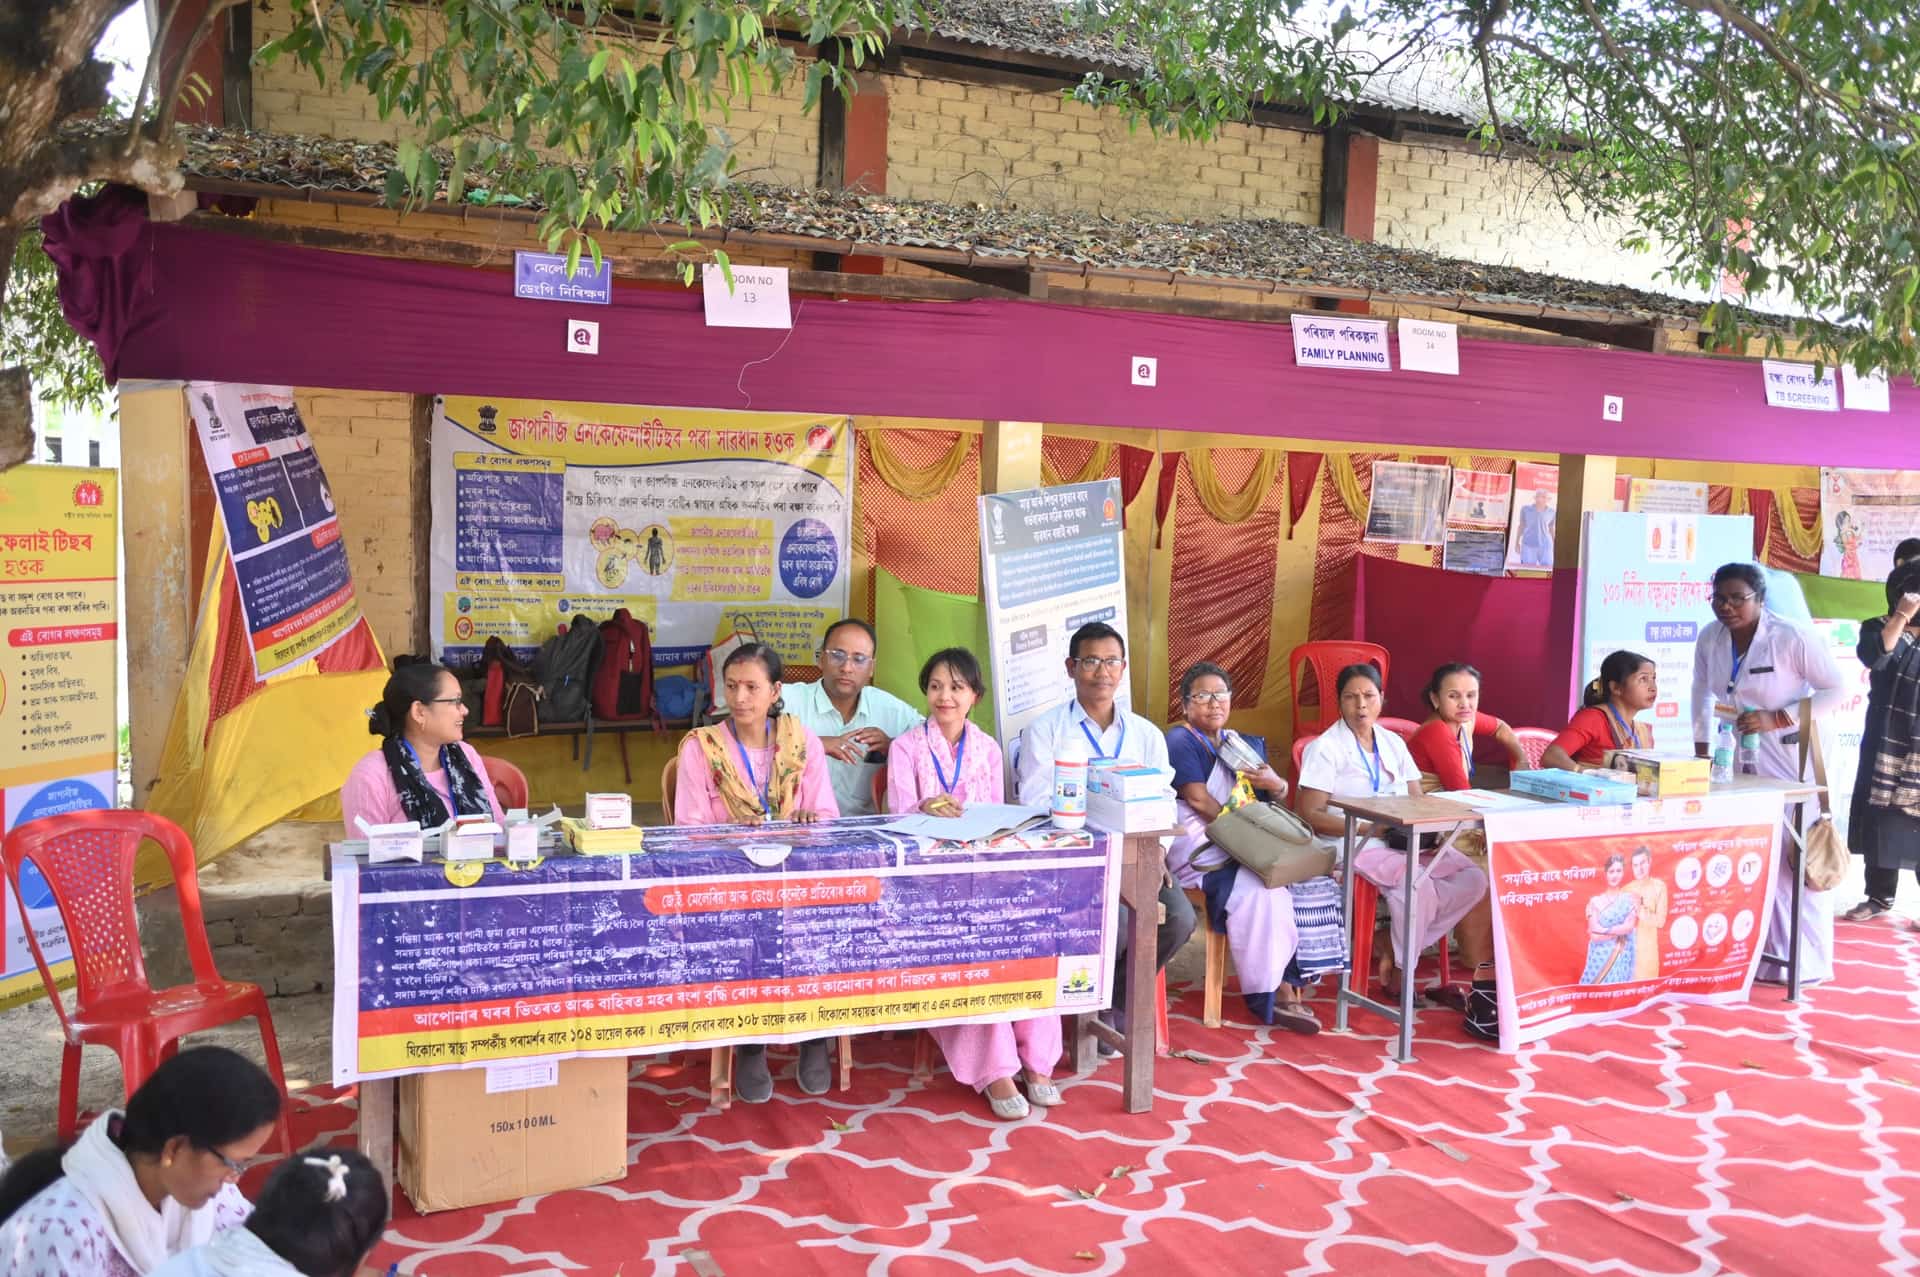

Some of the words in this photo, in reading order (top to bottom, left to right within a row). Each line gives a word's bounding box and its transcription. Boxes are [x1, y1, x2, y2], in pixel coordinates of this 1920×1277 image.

[726, 274, 755, 285] OOM
[758, 276, 773, 285] NO
[743, 292, 757, 303] 13
[1303, 324, 1335, 340] পৰিয়াল
[1339, 326, 1379, 344] পৰিকল্পনা
[1412, 327, 1435, 337] ROOM
[1301, 347, 1335, 360] FAMILY
[1337, 350, 1385, 363] PLANNING
[1776, 391, 1785, 401] TB
[1788, 392, 1830, 405] SCREENING
[508, 410, 569, 443] জাপানীজ
[688, 428, 711, 450] পৰা
[716, 427, 759, 452] সাৱধান
[764, 431, 795, 454] হওক
[5, 559, 44, 576] হওক
[20, 629, 34, 643] এই
[37, 630, 63, 642] ৰোগৰ
[1563, 865, 1597, 880] পৰিয়াল
[688, 886, 727, 907] মেলেৰিয়া
[730, 890, 749, 903] আৰু
[846, 880, 867, 897] কৰিব
[414, 1009, 478, 1027] আপোনাৰ
[482, 1006, 511, 1020] ঘৰৰ
[516, 1001, 562, 1018] ভিতৰত
[565, 999, 594, 1012] আৰু
[598, 993, 643, 1011] বাহিৰত
[648, 994, 673, 1008] মহৰ
[677, 991, 701, 1003] বংশ
[705, 985, 728, 1006] বৃদ্ধি
[731, 987, 758, 1001] ৰোধ
[823, 976, 873, 993] কামোৰাৰ
[878, 974, 897, 988] পৰা
[900, 971, 937, 987] নিজকে
[941, 970, 961, 983] ৰক্ষা
[964, 967, 990, 980] কৰক
[407, 1041, 446, 1059] যিকোনো
[510, 1030, 545, 1049] পৰামৰ্শৰ
[548, 1031, 567, 1045] বাবে
[570, 1028, 592, 1043] ১০৪
[595, 1027, 623, 1041] ডায়েল
[625, 1025, 646, 1039] কৰক
[717, 1016, 734, 1031] বাবে
[738, 1013, 759, 1028] ১০৮
[762, 1012, 786, 1027] ডায়েল
[788, 1011, 807, 1024] কৰক
[819, 1006, 850, 1022] যিকোনো
[885, 1002, 901, 1016] বাবে
[922, 1001, 930, 1013] বা
[931, 1001, 937, 1011] এ
[939, 999, 950, 1011] এন
[970, 996, 986, 1007] লগত
[1025, 990, 1043, 1001] কৰক
